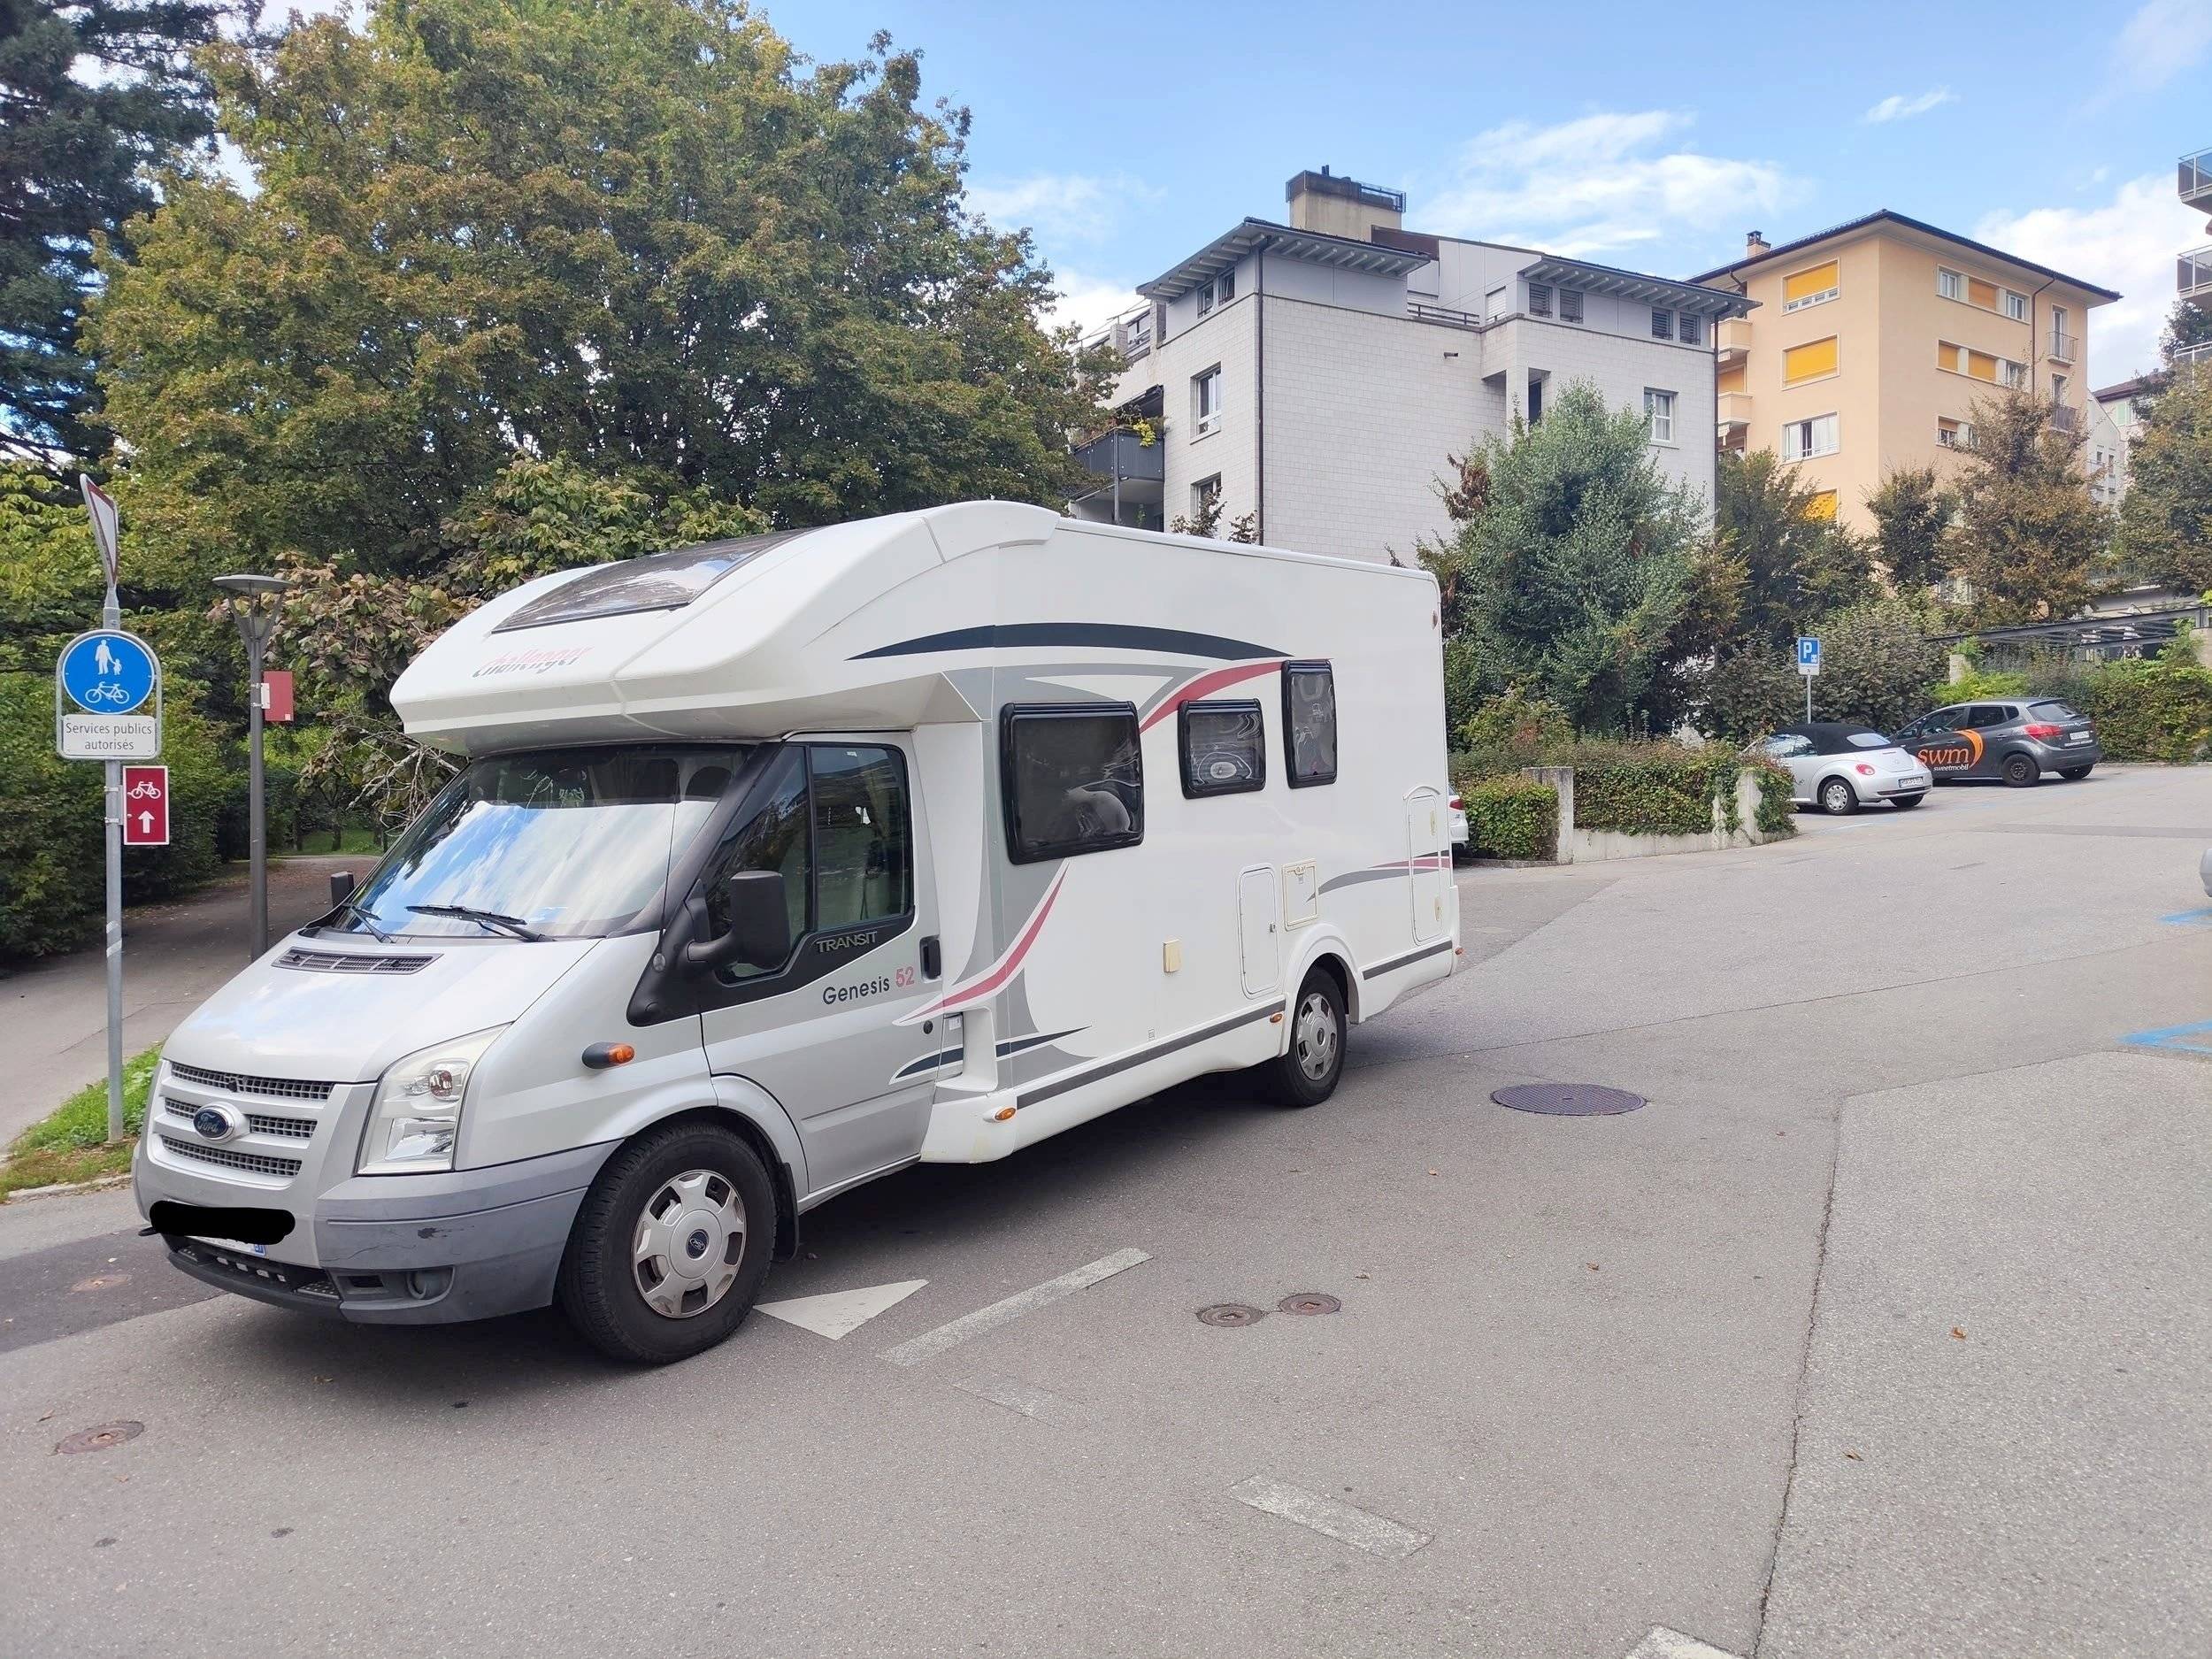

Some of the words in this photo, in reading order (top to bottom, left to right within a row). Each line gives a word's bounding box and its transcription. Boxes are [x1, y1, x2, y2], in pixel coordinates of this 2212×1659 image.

[1803, 641, 1812, 659] P
[65, 722, 111, 734] Services
[113, 723, 152, 737] publics
[84, 738, 134, 750] autorisés
[816, 930, 878, 954] TRANSIT
[822, 975, 890, 1005] Genesis
[895, 965, 915, 989] 52
